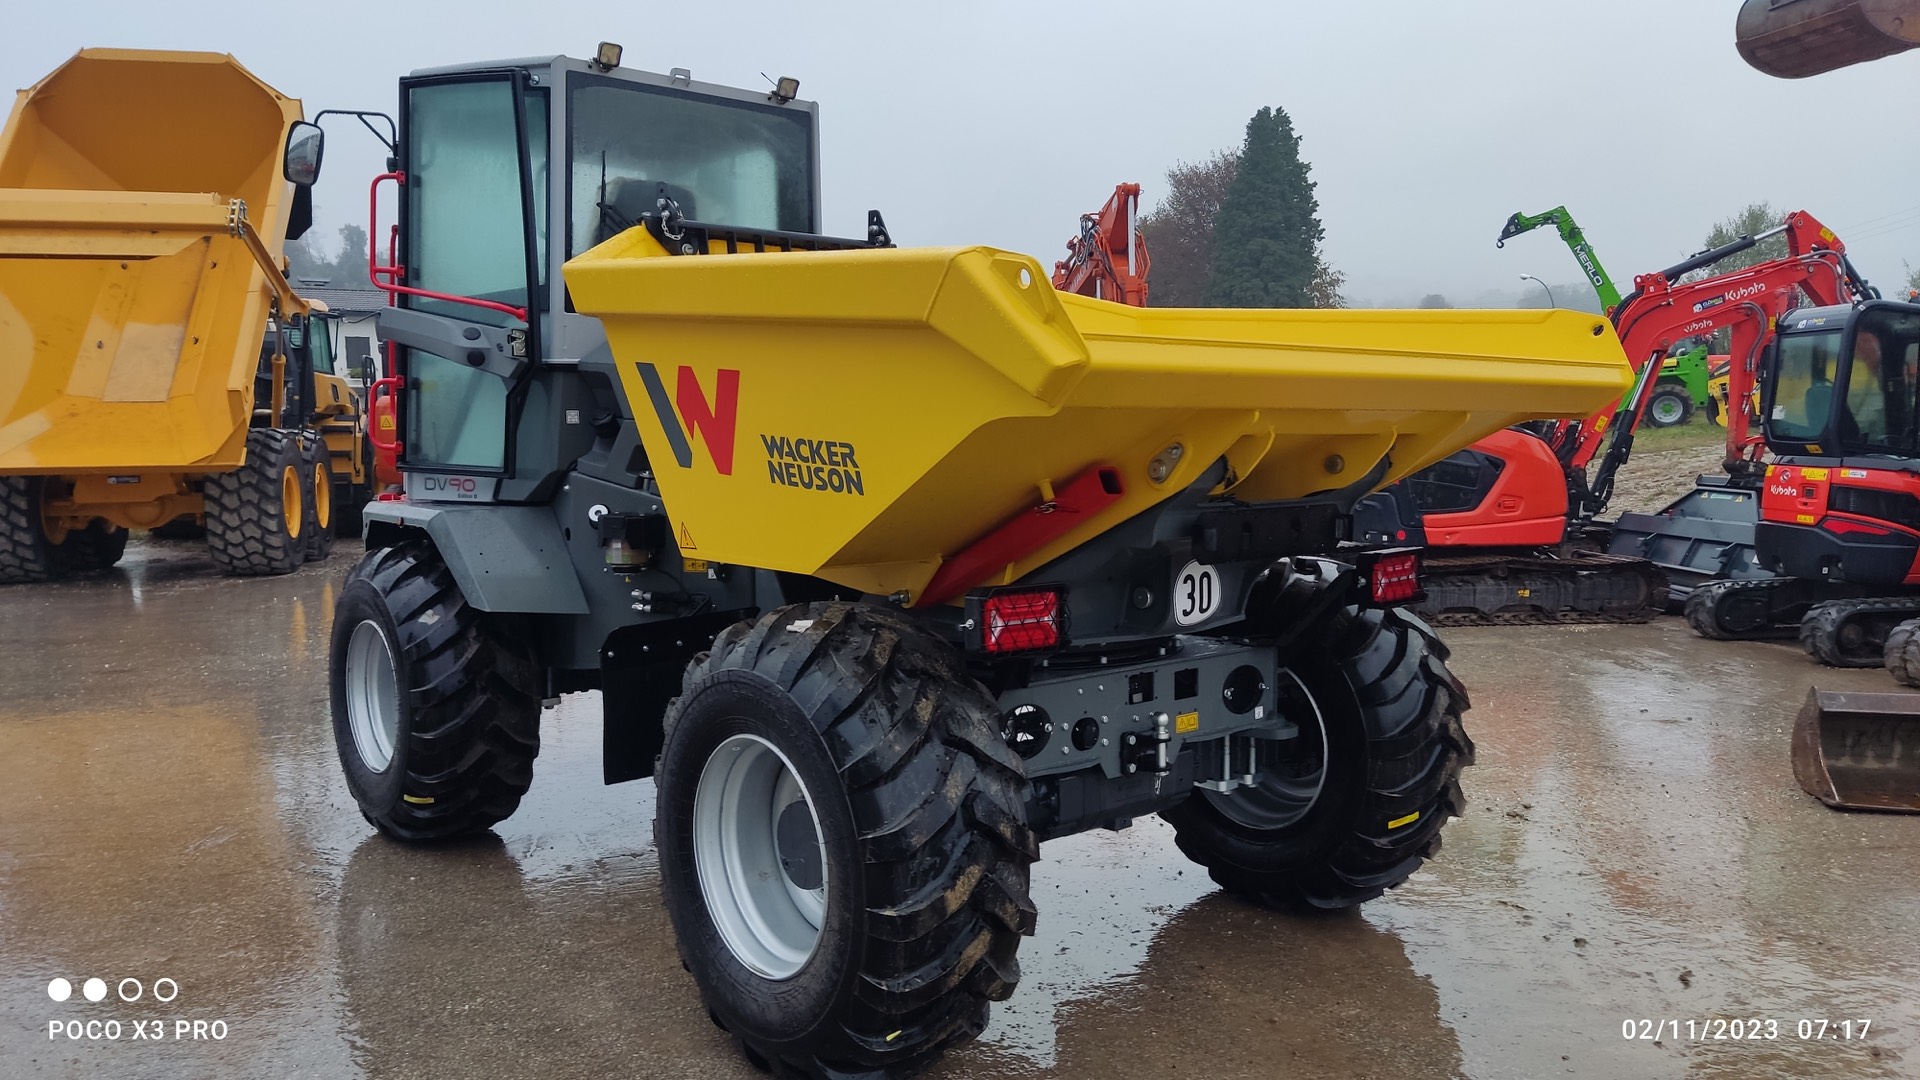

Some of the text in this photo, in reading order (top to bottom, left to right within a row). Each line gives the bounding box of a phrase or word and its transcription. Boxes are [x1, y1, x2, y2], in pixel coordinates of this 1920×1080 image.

[1574, 244, 1603, 286] MERLO
[1725, 282, 1766, 301] Kubota
[760, 434, 860, 468] WACKER
[767, 459, 865, 496] NEUSON
[1771, 484, 1797, 497] Kubota
[1182, 571, 1212, 617] 30
